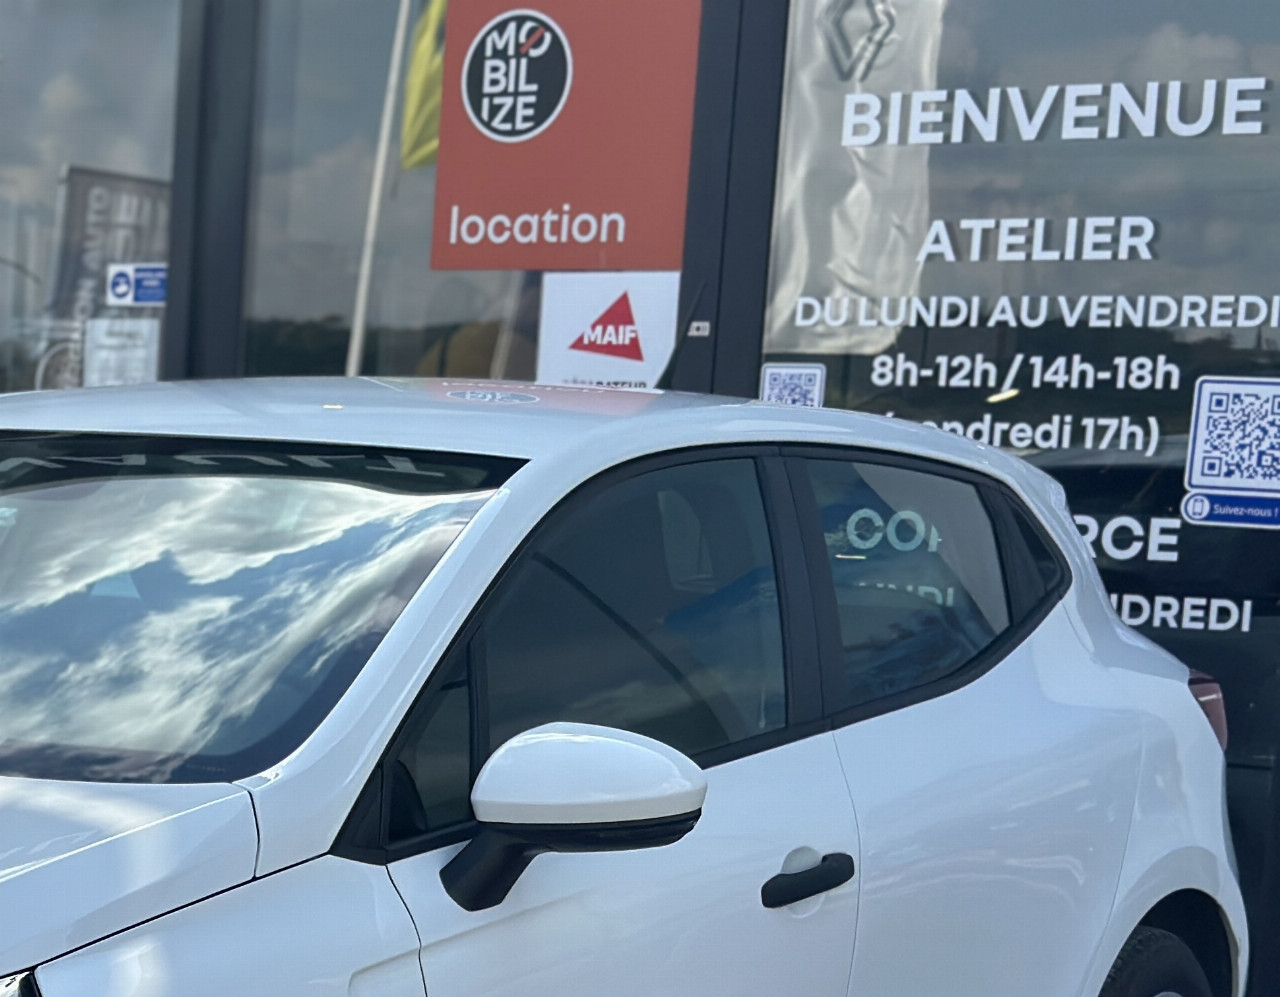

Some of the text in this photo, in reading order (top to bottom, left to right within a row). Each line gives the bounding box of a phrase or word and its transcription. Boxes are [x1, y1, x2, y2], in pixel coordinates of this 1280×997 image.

[482, 58, 538, 94] BIL
[481, 95, 537, 131] IZE
[841, 77, 1267, 147] BIENVENUE
[449, 204, 626, 245] location
[916, 216, 1156, 262] ATELIER
[794, 295, 1280, 328] DU LUNDI AU VENDREDI
[583, 325, 638, 346] MAIF
[871, 353, 998, 388] 8h-12h
[1029, 354, 1181, 390] 14h-18h
[1081, 415, 1159, 458] 17h)
[1213, 504, 1273, 518] Suivez-nous
